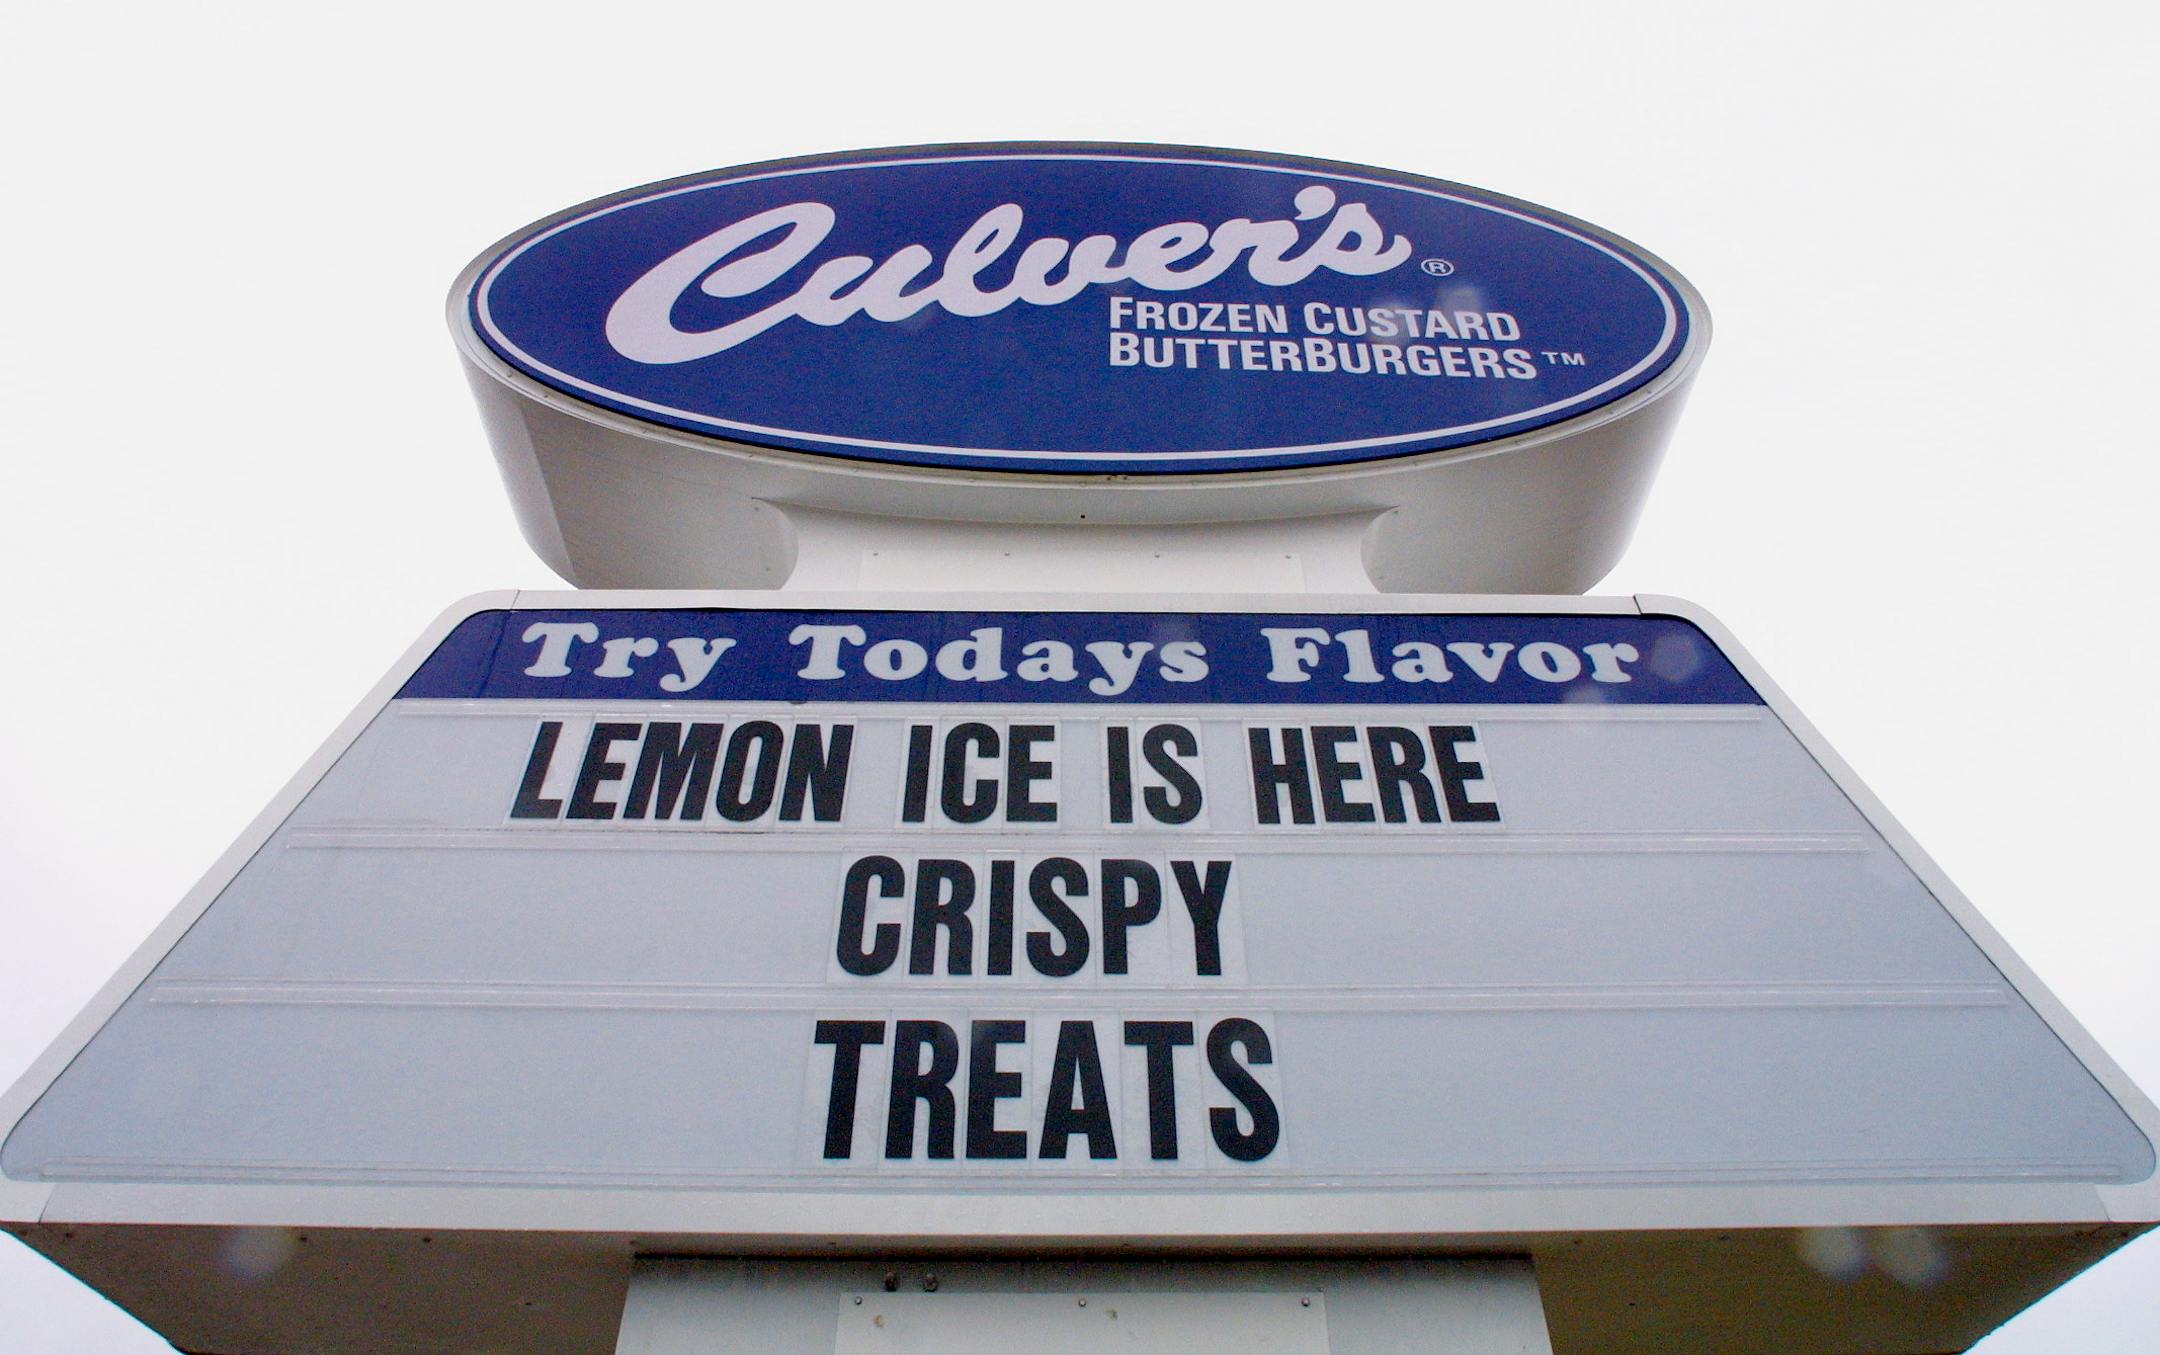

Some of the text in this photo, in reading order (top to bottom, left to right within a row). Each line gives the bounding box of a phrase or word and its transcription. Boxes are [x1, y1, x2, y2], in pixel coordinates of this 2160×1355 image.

[605, 186, 1412, 364] Culver's
[1109, 296, 1521, 341] FROZEN CUSTARD
[1109, 332, 1537, 380] BUTTERBURGERS
[522, 622, 1639, 696] Try Todays Flavor
[510, 721, 1501, 825] LEMON ICE IS HERE
[836, 855, 1233, 978] CRISPY
[813, 1018, 1281, 1163] TREATS
